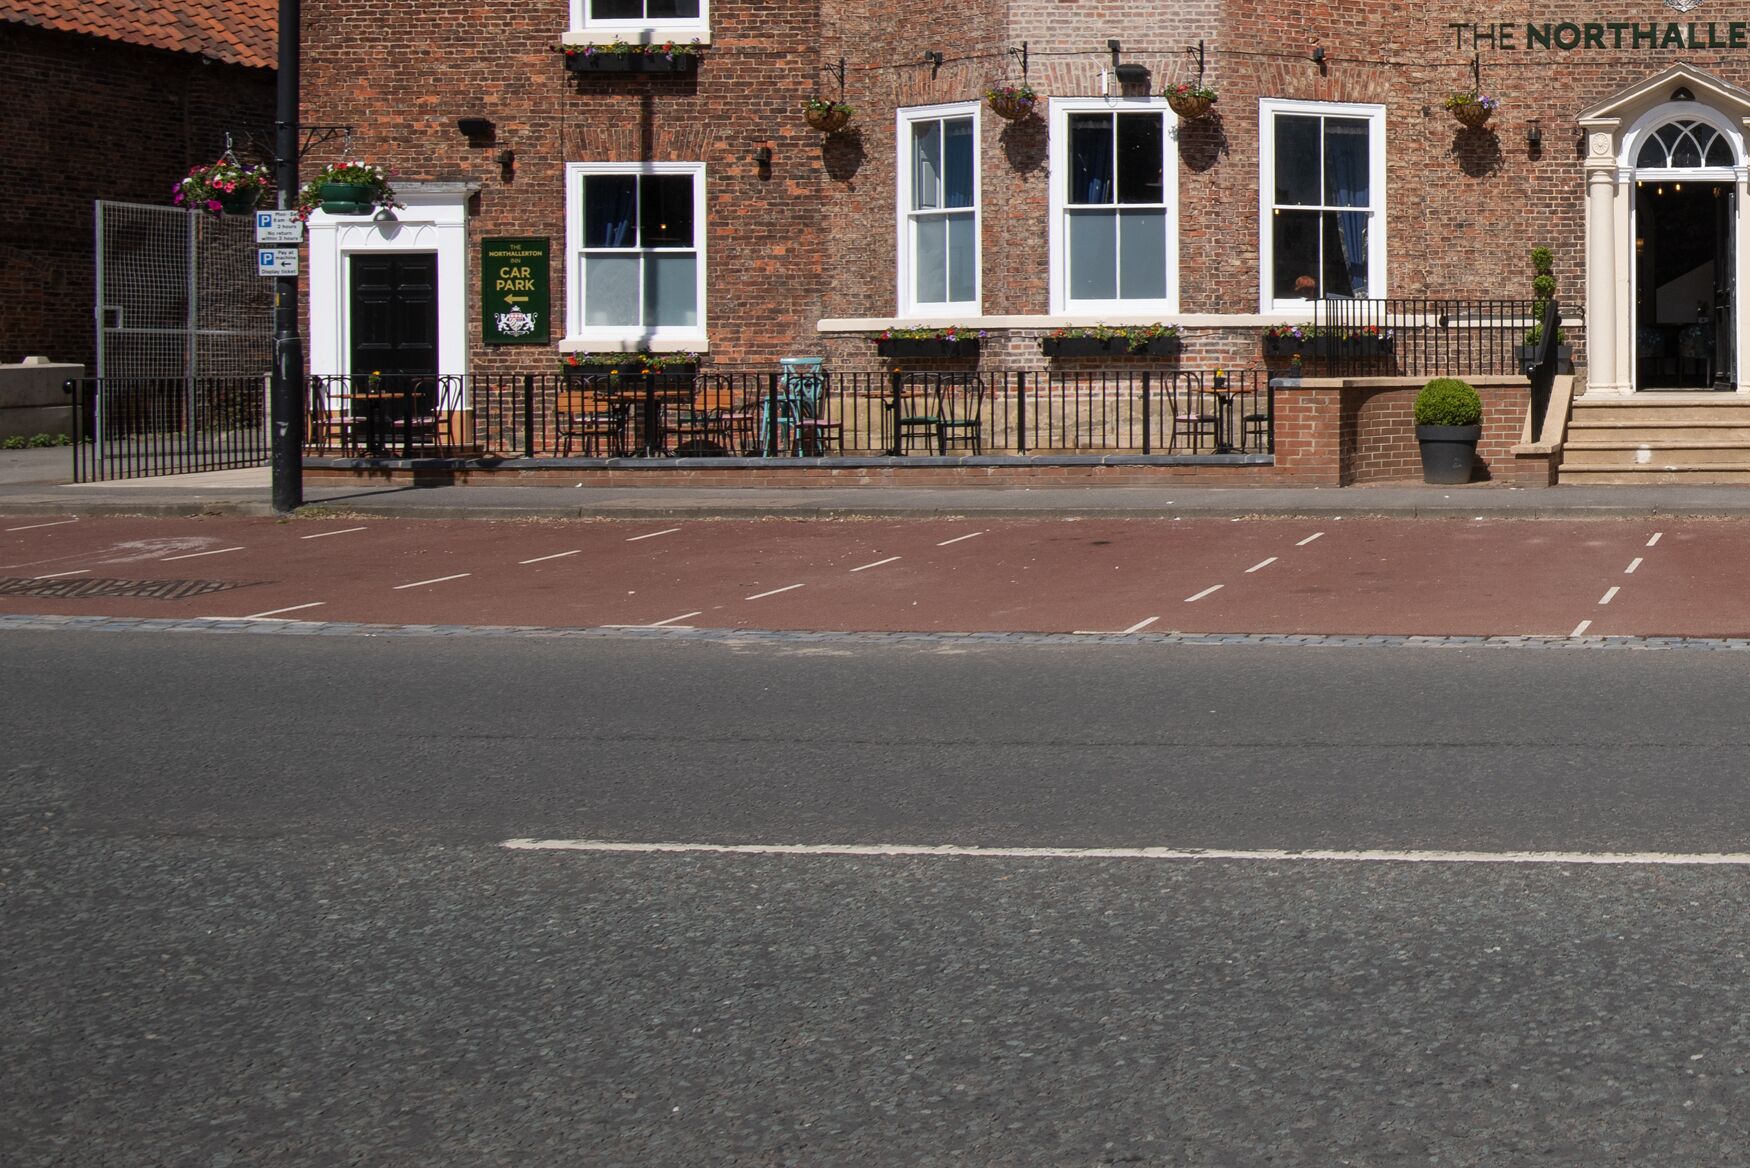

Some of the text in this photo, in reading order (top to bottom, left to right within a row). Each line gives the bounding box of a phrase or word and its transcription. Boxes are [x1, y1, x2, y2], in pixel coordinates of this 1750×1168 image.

[1449, 22, 1516, 50] THE
[500, 267, 530, 278] CAR
[496, 280, 535, 291] PARK
